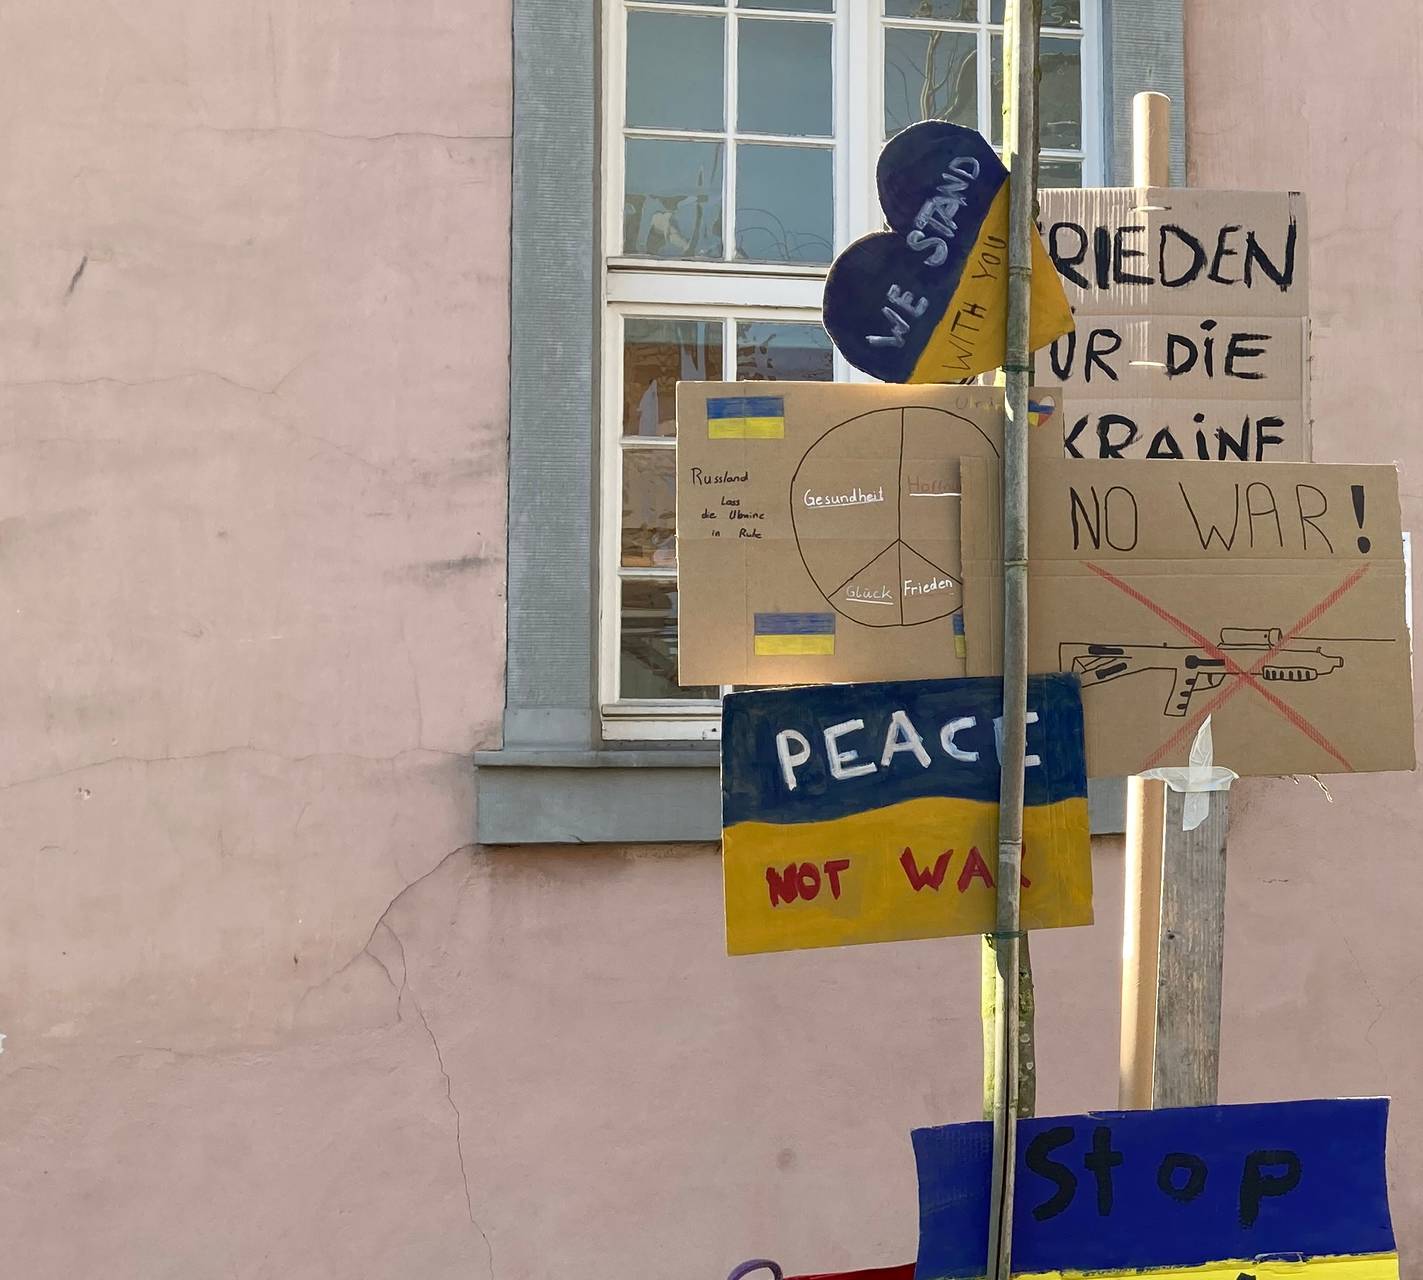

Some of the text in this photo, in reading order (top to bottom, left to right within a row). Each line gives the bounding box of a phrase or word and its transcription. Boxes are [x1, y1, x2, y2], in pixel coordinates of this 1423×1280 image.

[865, 156, 981, 348] WE STAND
[1036, 214, 1297, 292] RIEDEN
[942, 235, 1008, 370] WITH YOU
[1048, 306, 1120, 383] ÜR
[691, 467, 749, 486] Russland
[803, 486, 885, 507] Gesundheit
[702, 509, 718, 519] die
[721, 496, 740, 507] Lass
[1070, 485, 1138, 552] NO
[847, 584, 893, 600] Glück
[904, 577, 953, 597] Frieden
[766, 859, 850, 907] NOT
[1025, 1126, 1302, 1229] Stop
